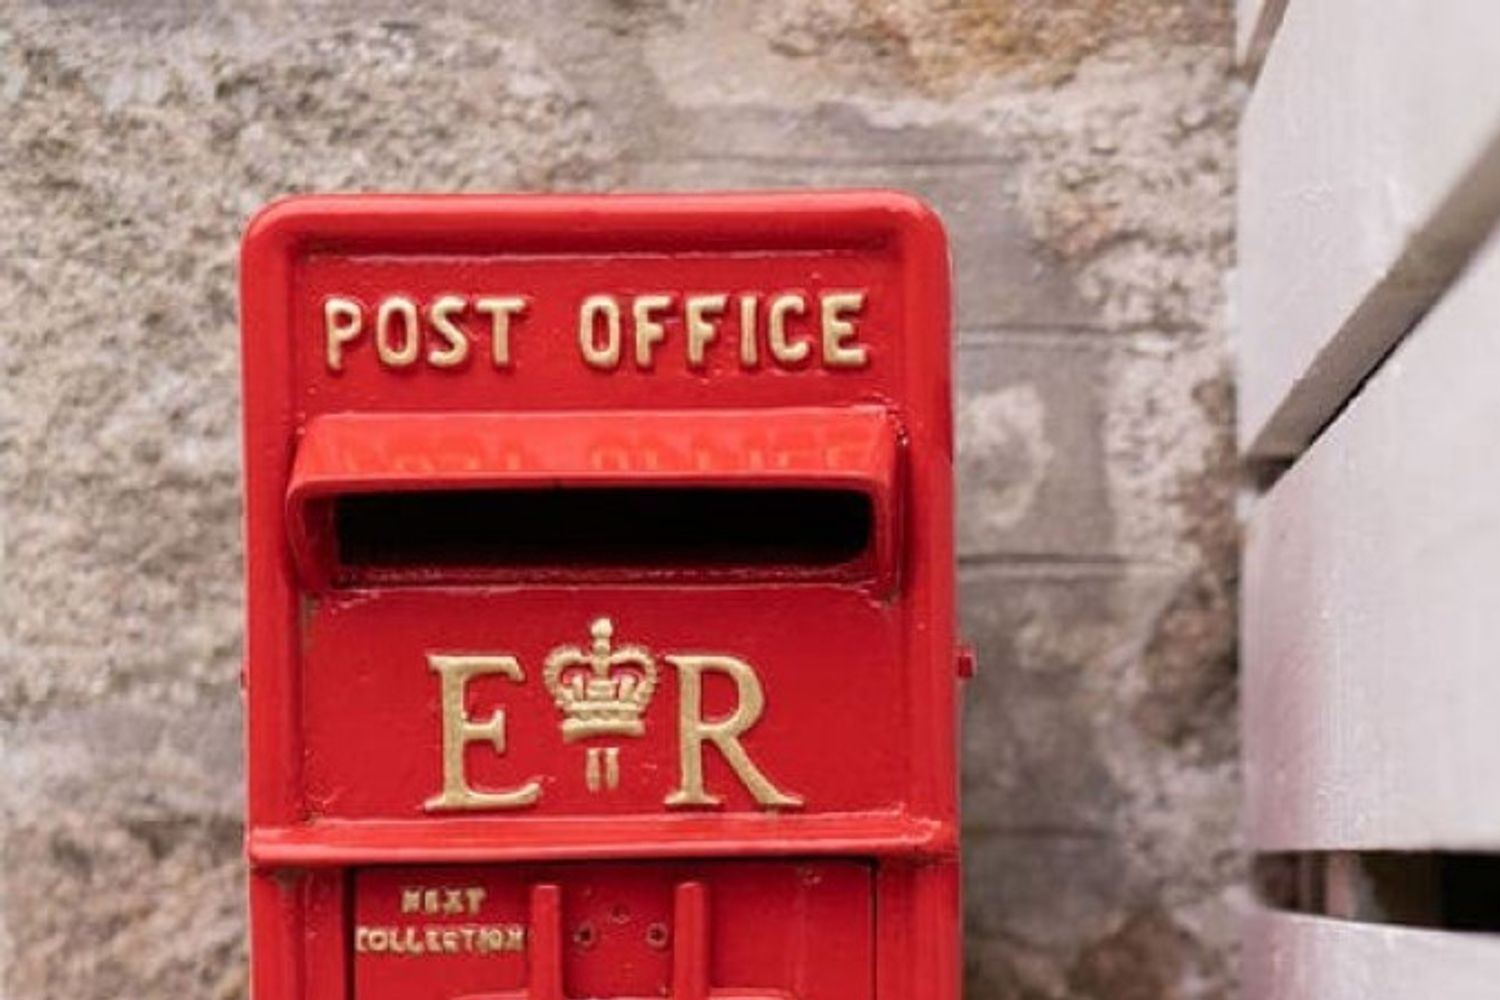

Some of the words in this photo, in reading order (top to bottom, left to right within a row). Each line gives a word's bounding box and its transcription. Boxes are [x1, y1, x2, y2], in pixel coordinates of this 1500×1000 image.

[325, 297, 527, 370] POST
[578, 293, 869, 367] OFFICE
[423, 653, 541, 811] E
[664, 655, 804, 808] R
[402, 887, 486, 914] NEXT
[356, 926, 525, 953] COLLECTION
